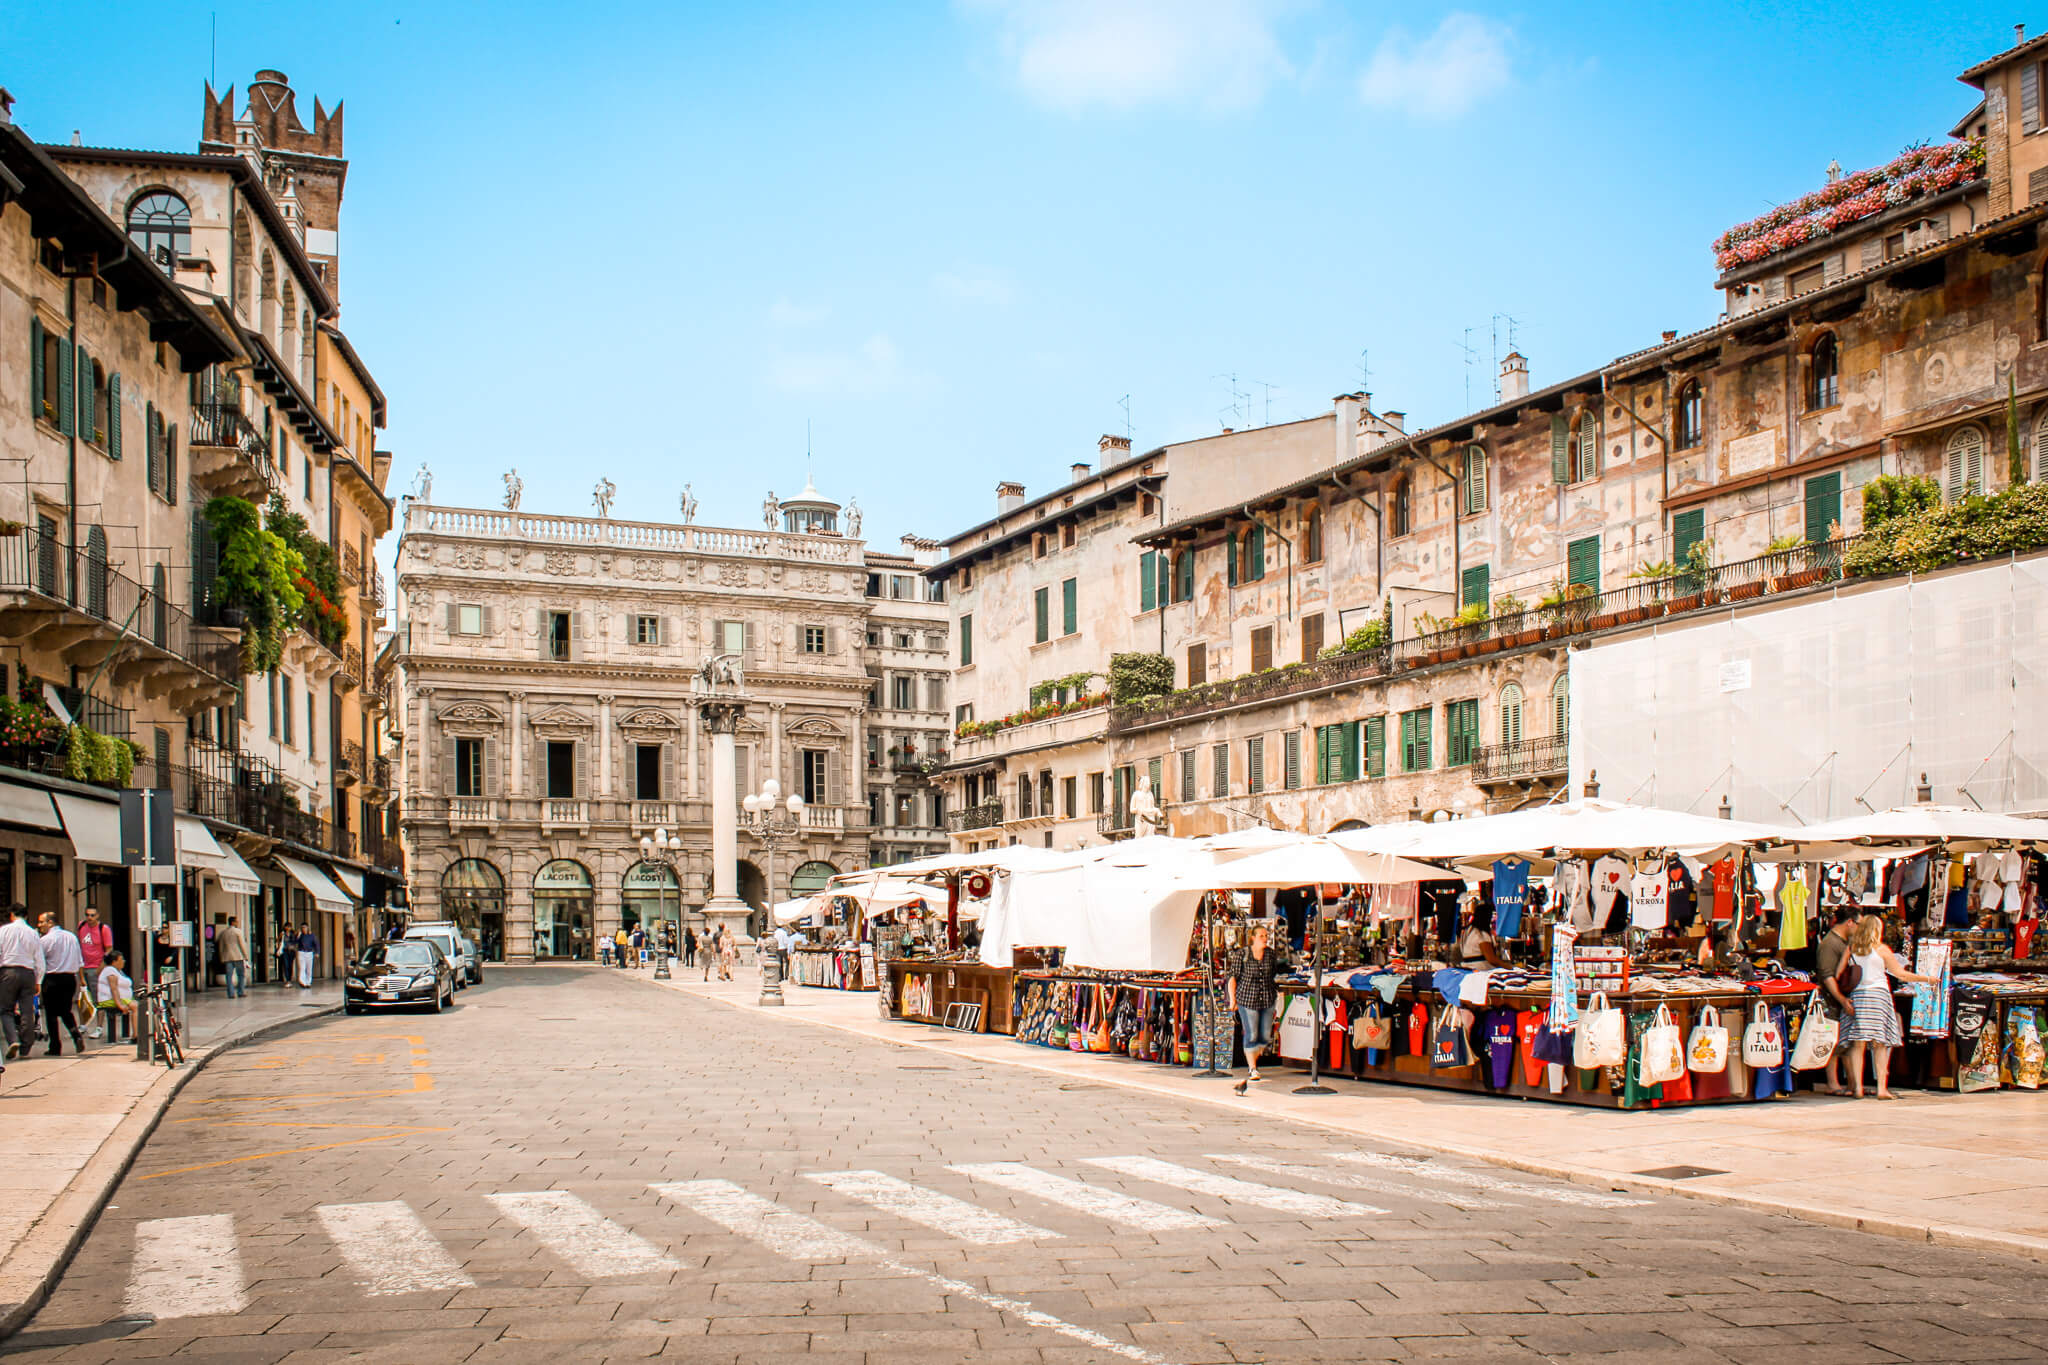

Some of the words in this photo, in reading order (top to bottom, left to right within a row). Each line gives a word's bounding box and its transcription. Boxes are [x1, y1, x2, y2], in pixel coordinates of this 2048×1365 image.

[543, 873, 579, 881] LACOSTE
[1640, 887, 1645, 898] I
[1496, 896, 1523, 905] ITALIA
[1288, 1016, 1312, 1027] ITALIA
[1756, 1032, 1761, 1044] I
[1436, 1042, 1442, 1055] I
[1750, 1044, 1778, 1052] ITALIA
[1434, 1053, 1455, 1064] ITALIA
